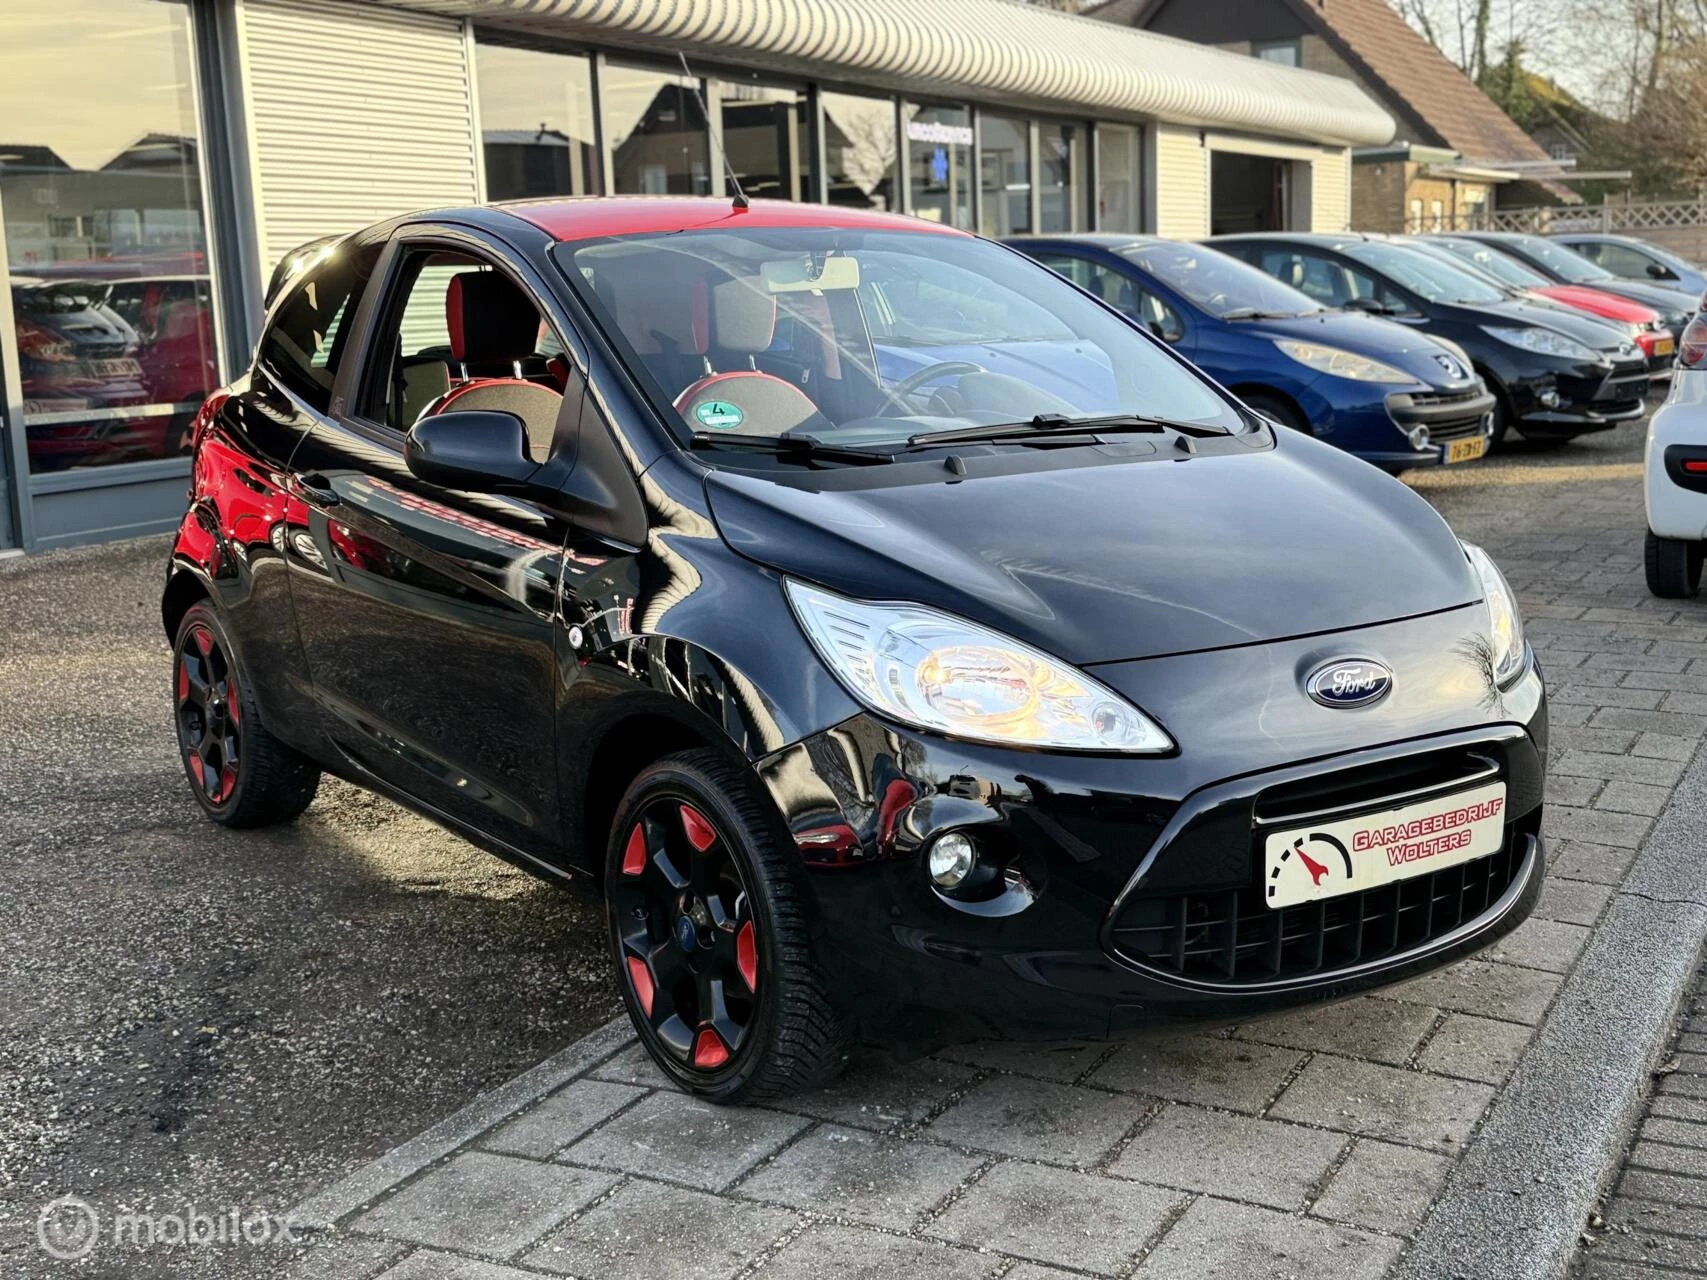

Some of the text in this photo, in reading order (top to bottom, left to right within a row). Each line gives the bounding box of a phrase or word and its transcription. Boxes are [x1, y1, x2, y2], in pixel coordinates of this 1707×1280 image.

[712, 403, 725, 415] 4
[1332, 667, 1376, 697] Ford
[1353, 798, 1503, 852] GARAGEBEDRIJF
[1387, 829, 1471, 867] WOLTERS
